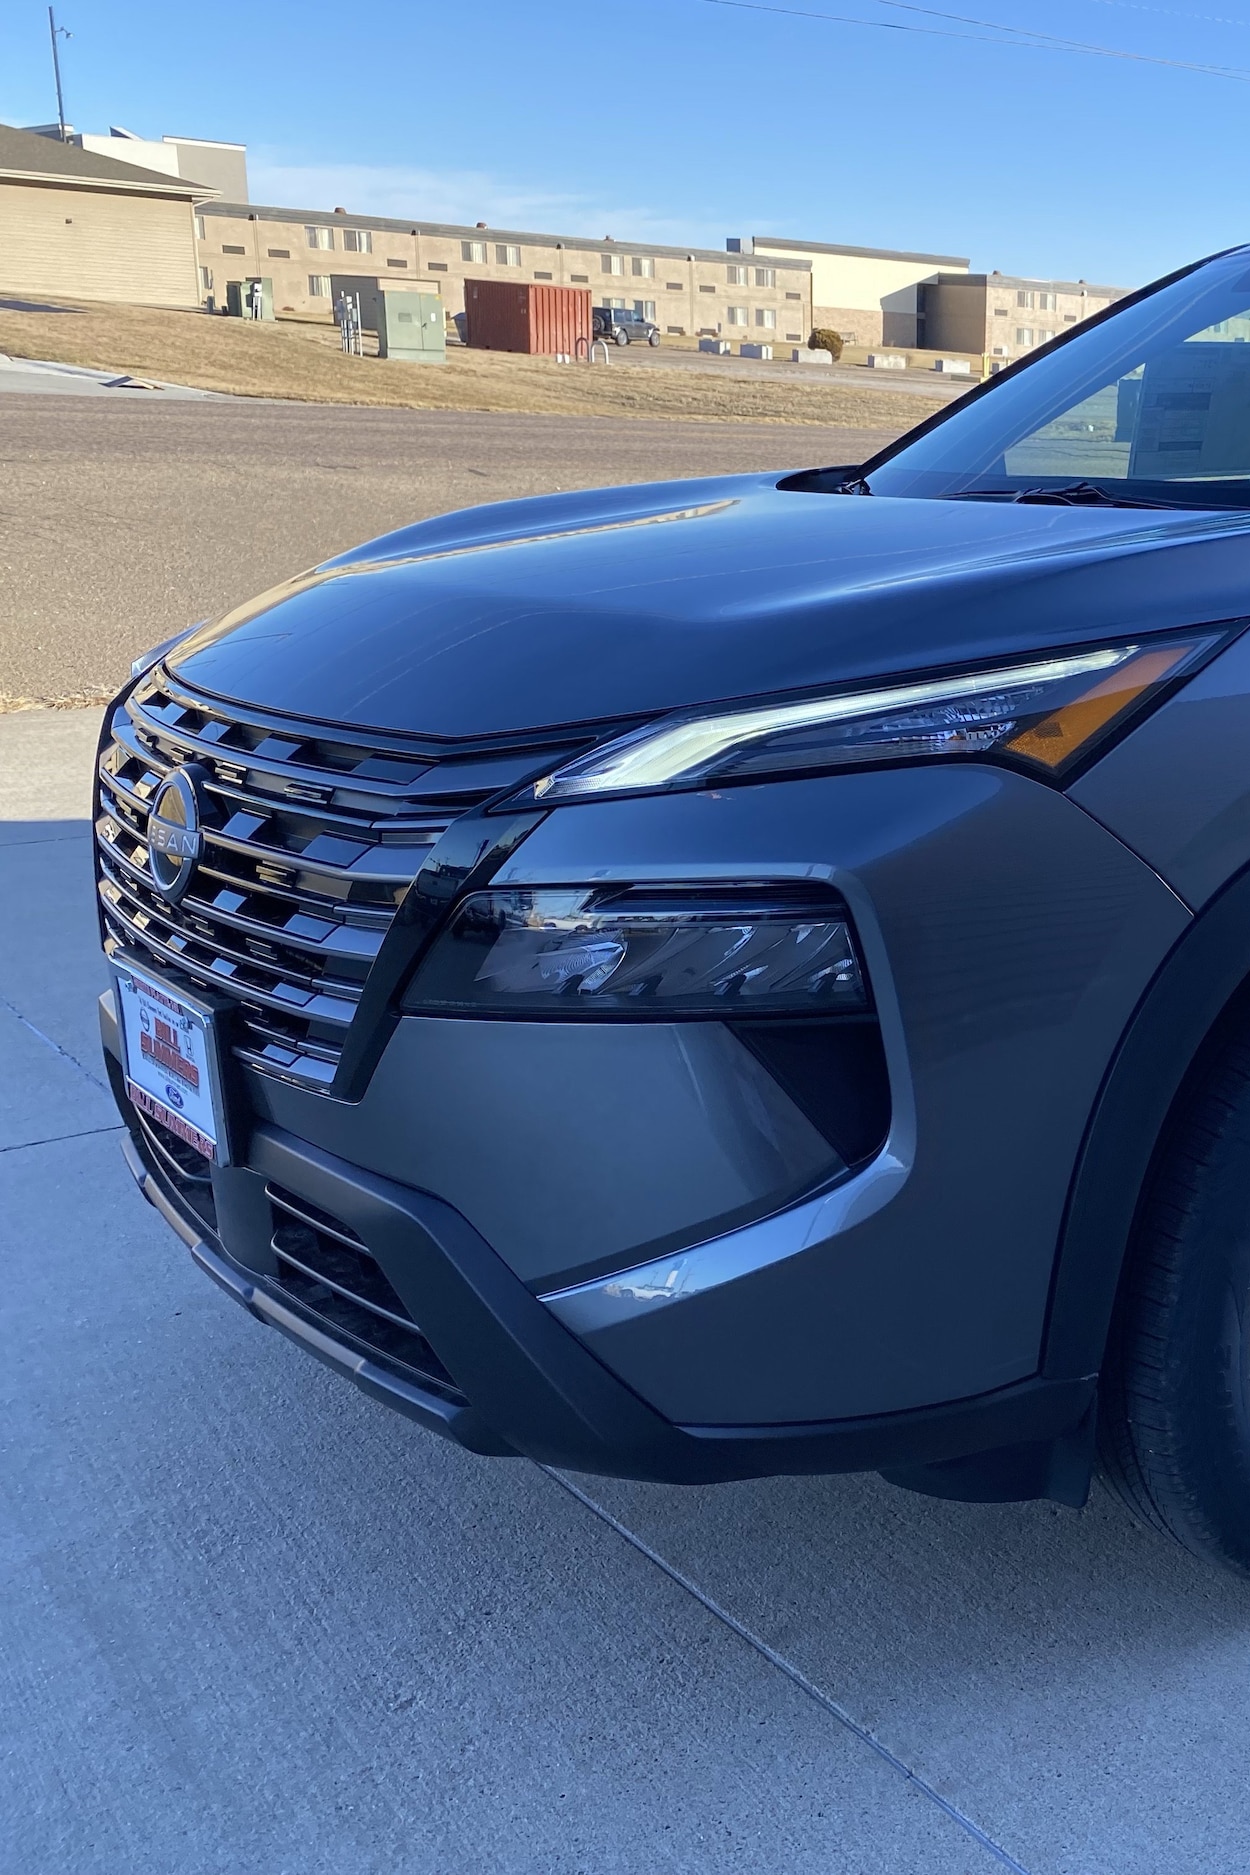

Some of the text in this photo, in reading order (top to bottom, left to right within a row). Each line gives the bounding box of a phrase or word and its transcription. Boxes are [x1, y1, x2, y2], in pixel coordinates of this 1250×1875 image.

[150, 825, 197, 855] SSAN
[141, 1031, 199, 1086] SUMMERS
[154, 1106, 214, 1160] SUMMERS
